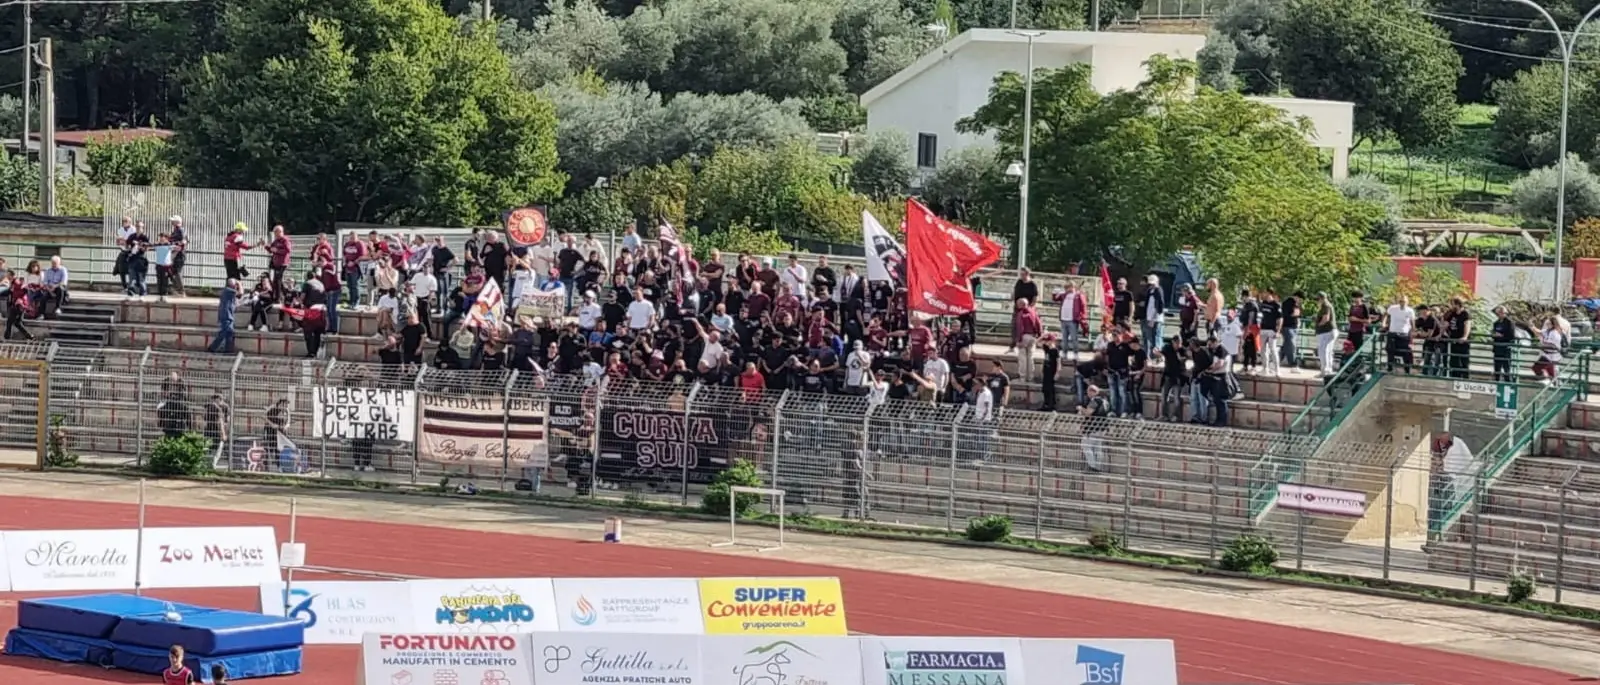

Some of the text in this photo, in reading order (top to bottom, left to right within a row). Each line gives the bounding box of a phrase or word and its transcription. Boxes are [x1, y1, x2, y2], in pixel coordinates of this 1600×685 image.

[1463, 384, 1486, 393] Uscita
[424, 394, 492, 411] DIFFIDATI
[325, 405, 360, 421] PER
[325, 421, 398, 441] ULTRAS
[613, 411, 718, 444] CURVA
[434, 439, 531, 460] Reggio Cabria
[637, 441, 698, 468] SUD
[25, 541, 128, 567] Marotta
[159, 545, 263, 563] Zoo Market
[440, 594, 524, 608] PANINERIA DEL
[735, 588, 806, 602] SUPER
[327, 597, 366, 610] BLAS
[708, 600, 836, 618] Conveniente
[328, 616, 396, 624] COSTRUZIONI
[742, 619, 805, 631] gruppoarena.it
[380, 635, 516, 651] FORTUNATO
[383, 657, 517, 666] MANUFATTI IN CEMENTO
[581, 646, 653, 674] Guttilla
[910, 654, 996, 668] FARMACIA
[623, 676, 666, 684] PRATICHE
[888, 673, 1004, 685] MESSANA
[1087, 662, 1120, 684] Bsf
